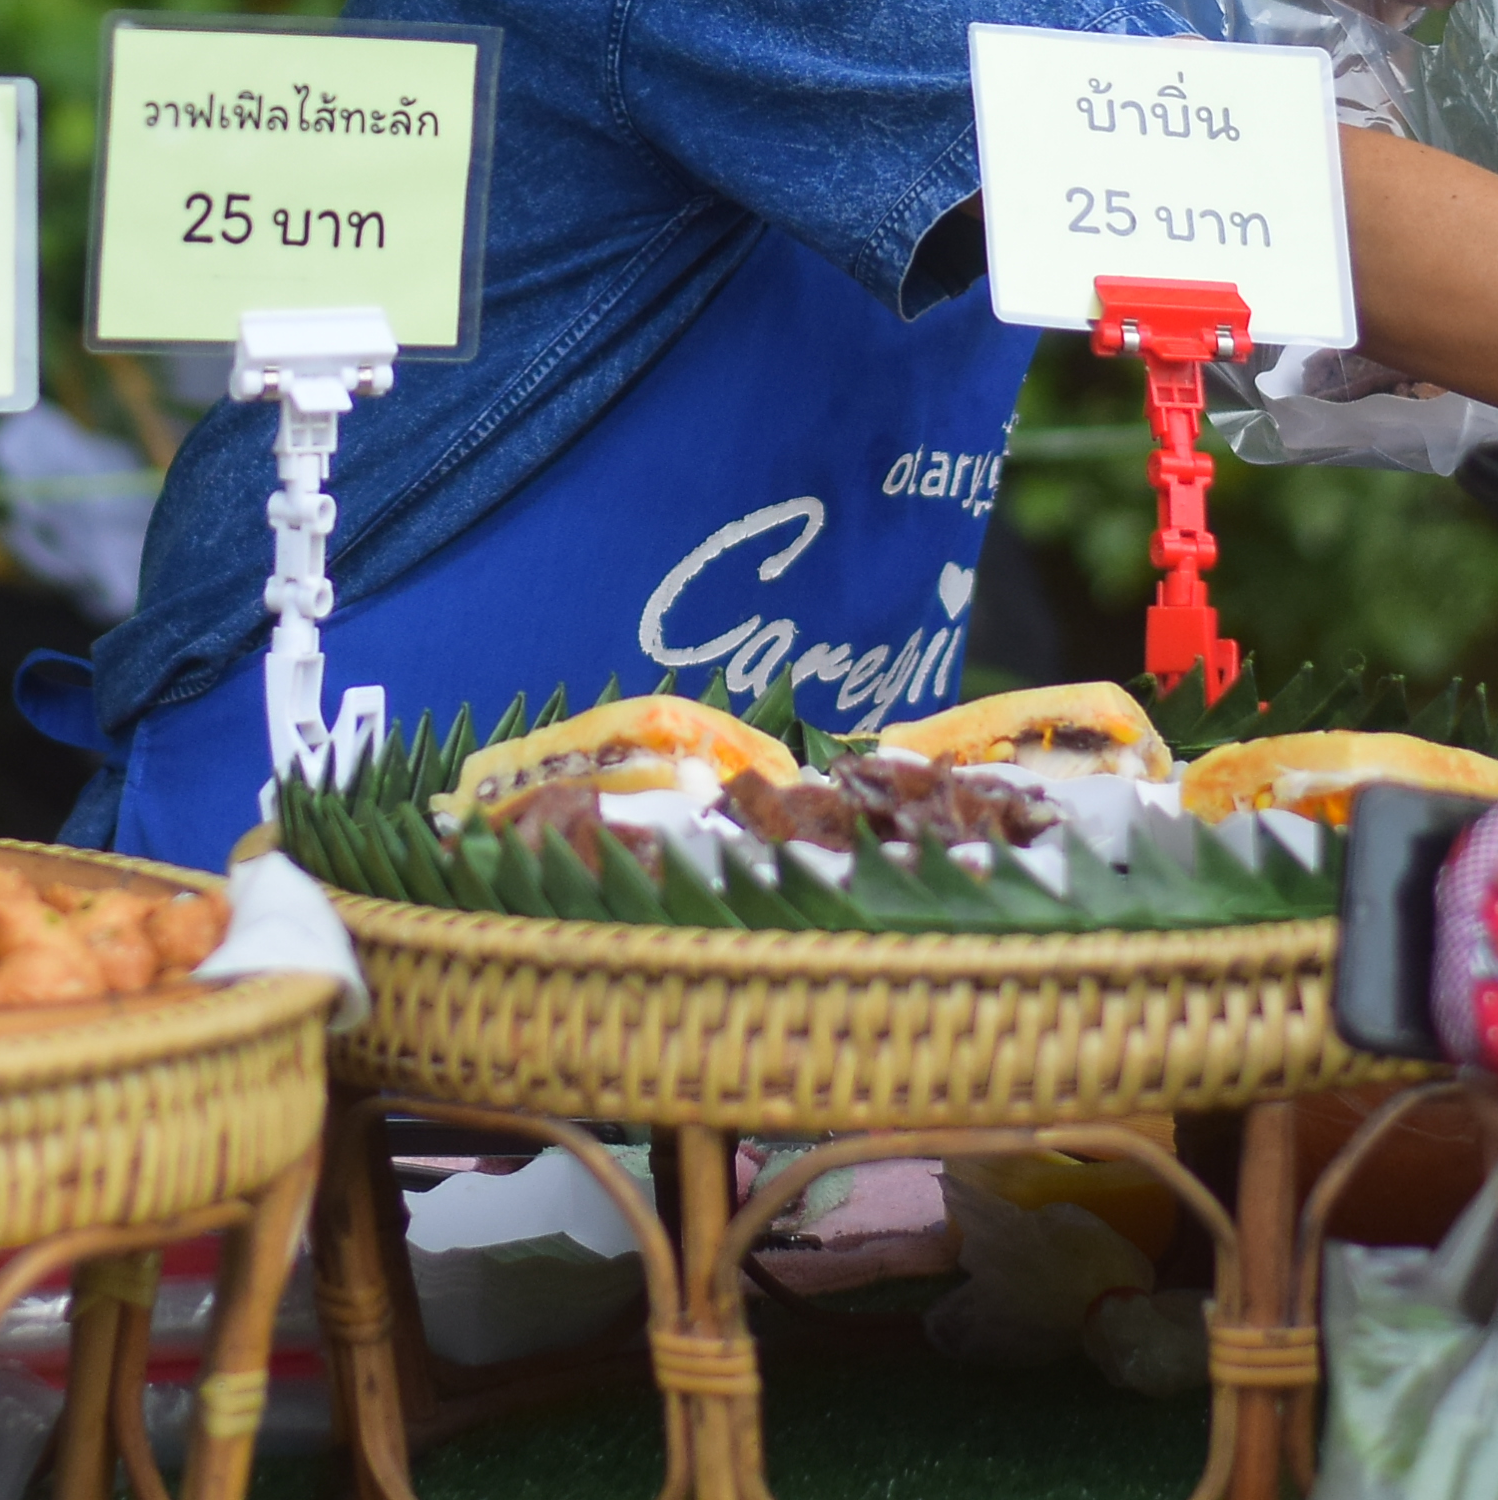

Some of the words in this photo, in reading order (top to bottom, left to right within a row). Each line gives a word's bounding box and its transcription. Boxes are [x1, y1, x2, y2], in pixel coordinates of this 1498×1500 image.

[143, 84, 440, 138] วาฟเฟิลไส้ทะลัก
[1076, 71, 1241, 142] บ้าบิ่น
[182, 191, 254, 245] 25
[272, 207, 386, 249] บาท
[1065, 186, 1138, 237] 25
[1155, 205, 1272, 248] บาท
